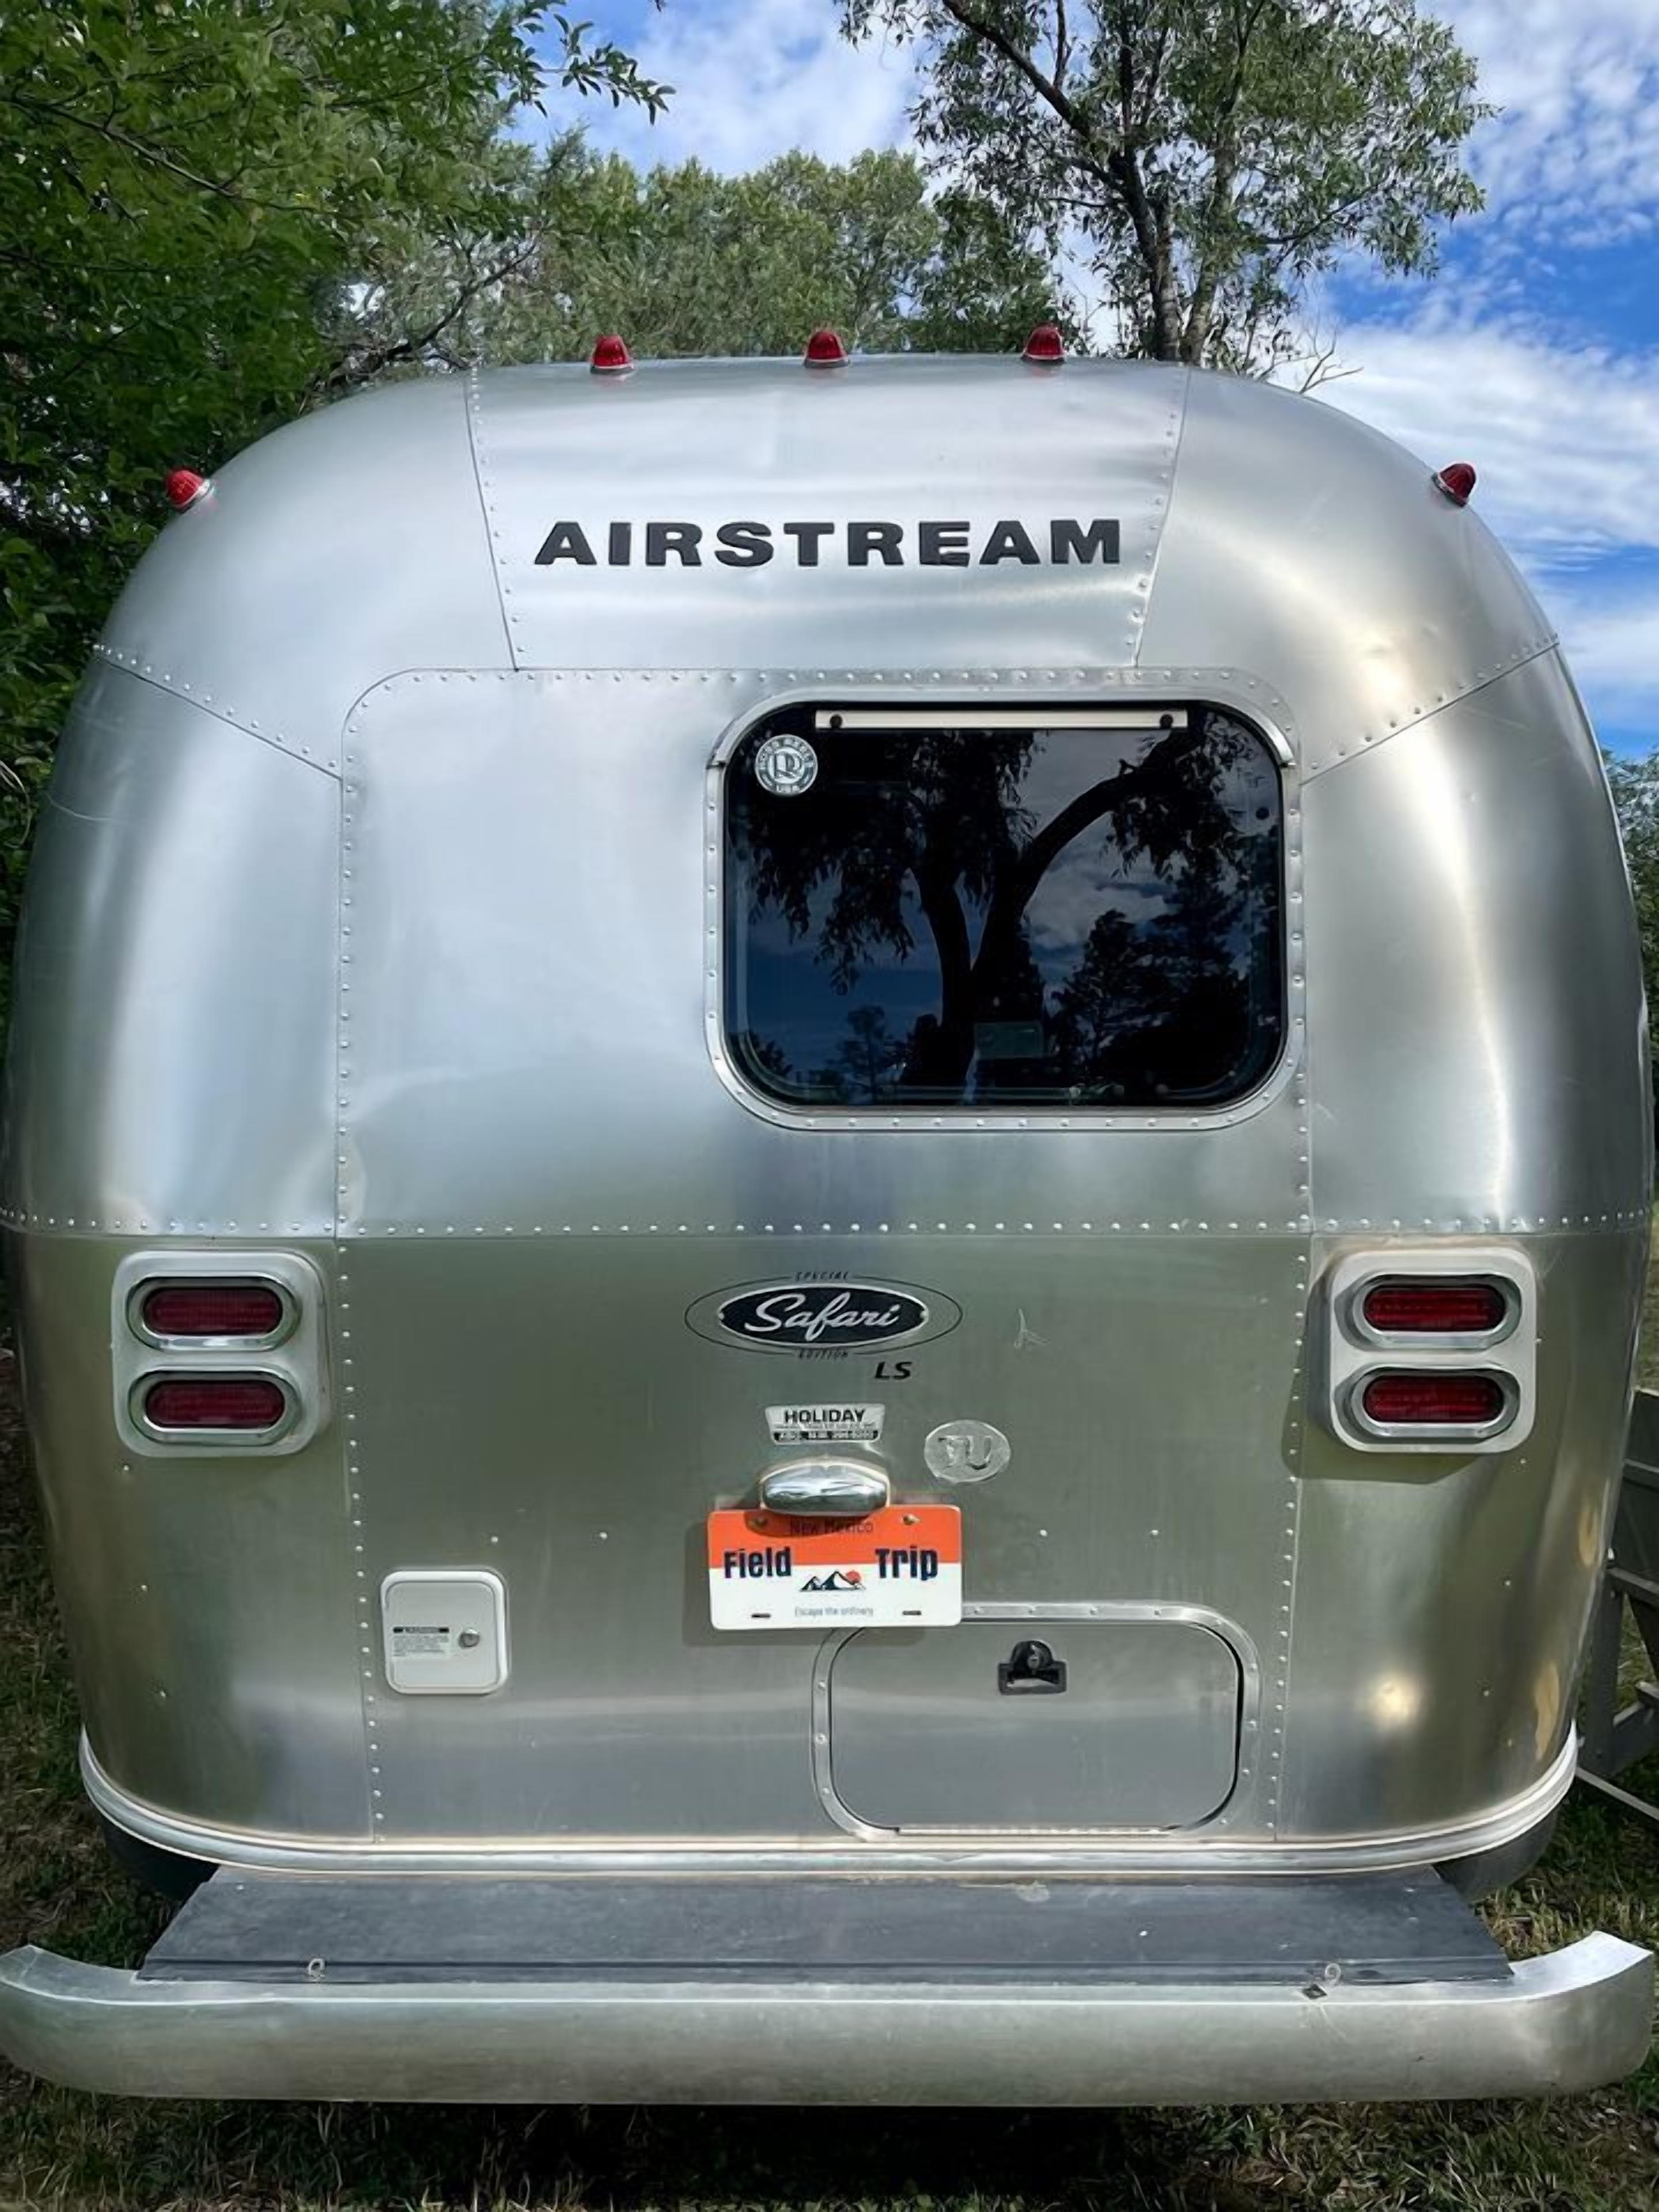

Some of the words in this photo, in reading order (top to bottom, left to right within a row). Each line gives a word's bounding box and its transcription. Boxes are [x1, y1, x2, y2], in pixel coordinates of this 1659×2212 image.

[534, 520, 1120, 567] AIRSTREAM
[744, 1291, 901, 1341] Safari
[875, 1361, 912, 1379] LS
[785, 1409, 866, 1423] HOLIDAY
[724, 1546, 792, 1579] Field
[875, 1544, 938, 1581] Trip
